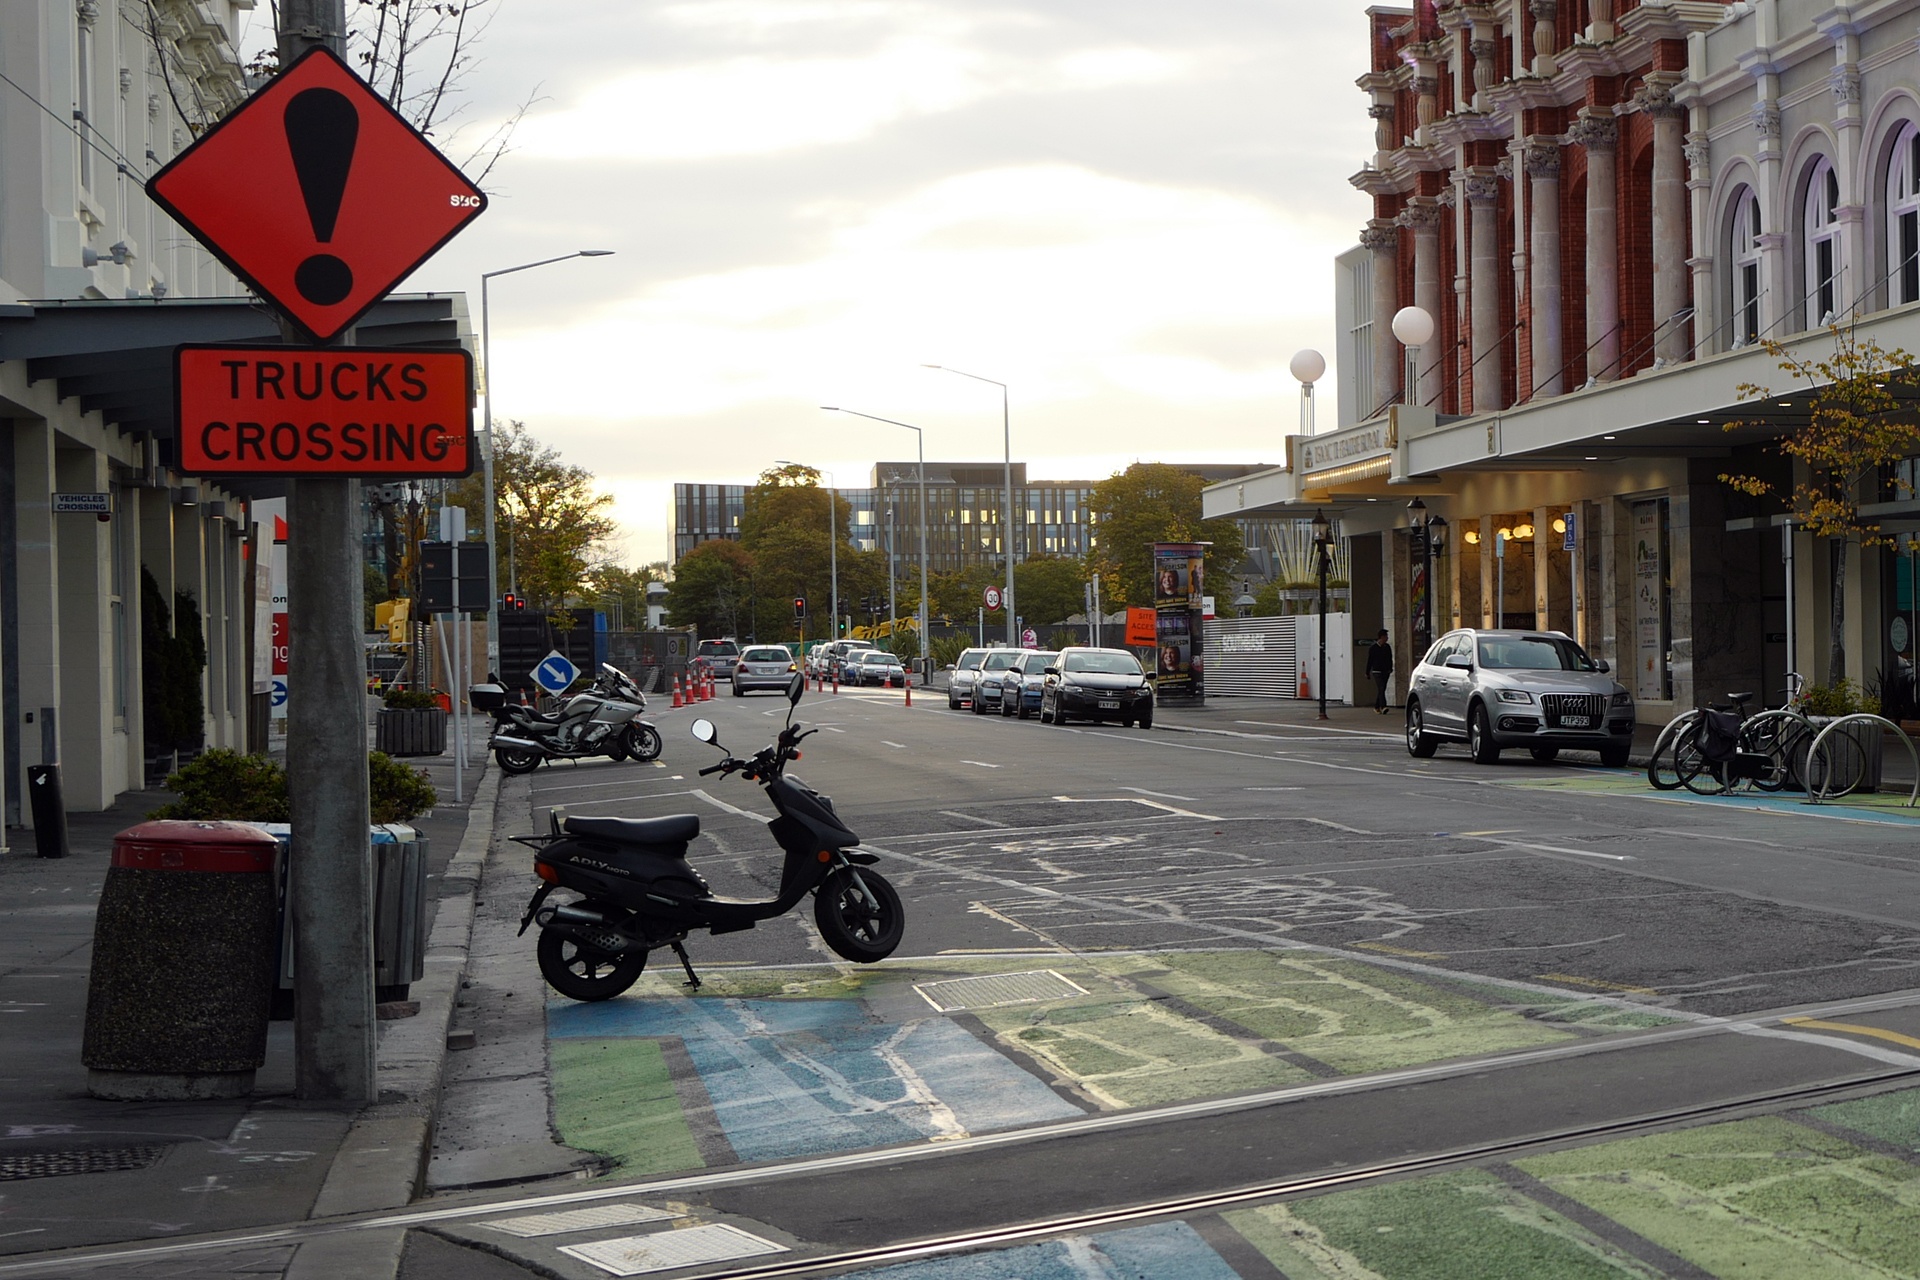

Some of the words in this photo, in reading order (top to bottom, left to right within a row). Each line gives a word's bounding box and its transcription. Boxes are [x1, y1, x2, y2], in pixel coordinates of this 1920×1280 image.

[220, 360, 428, 402] TRUCKS
[201, 421, 448, 462] CROSSING
[58, 495, 105, 503] VEHICLES
[57, 503, 107, 511] CROSSING
[988, 593, 998, 603] 30
[1131, 622, 1155, 631] ACCES
[1222, 634, 1265, 652] SOUTHBASE
[1561, 716, 1589, 725] JTP393
[570, 856, 608, 869] ADLY
[606, 865, 630, 876] MOTO
